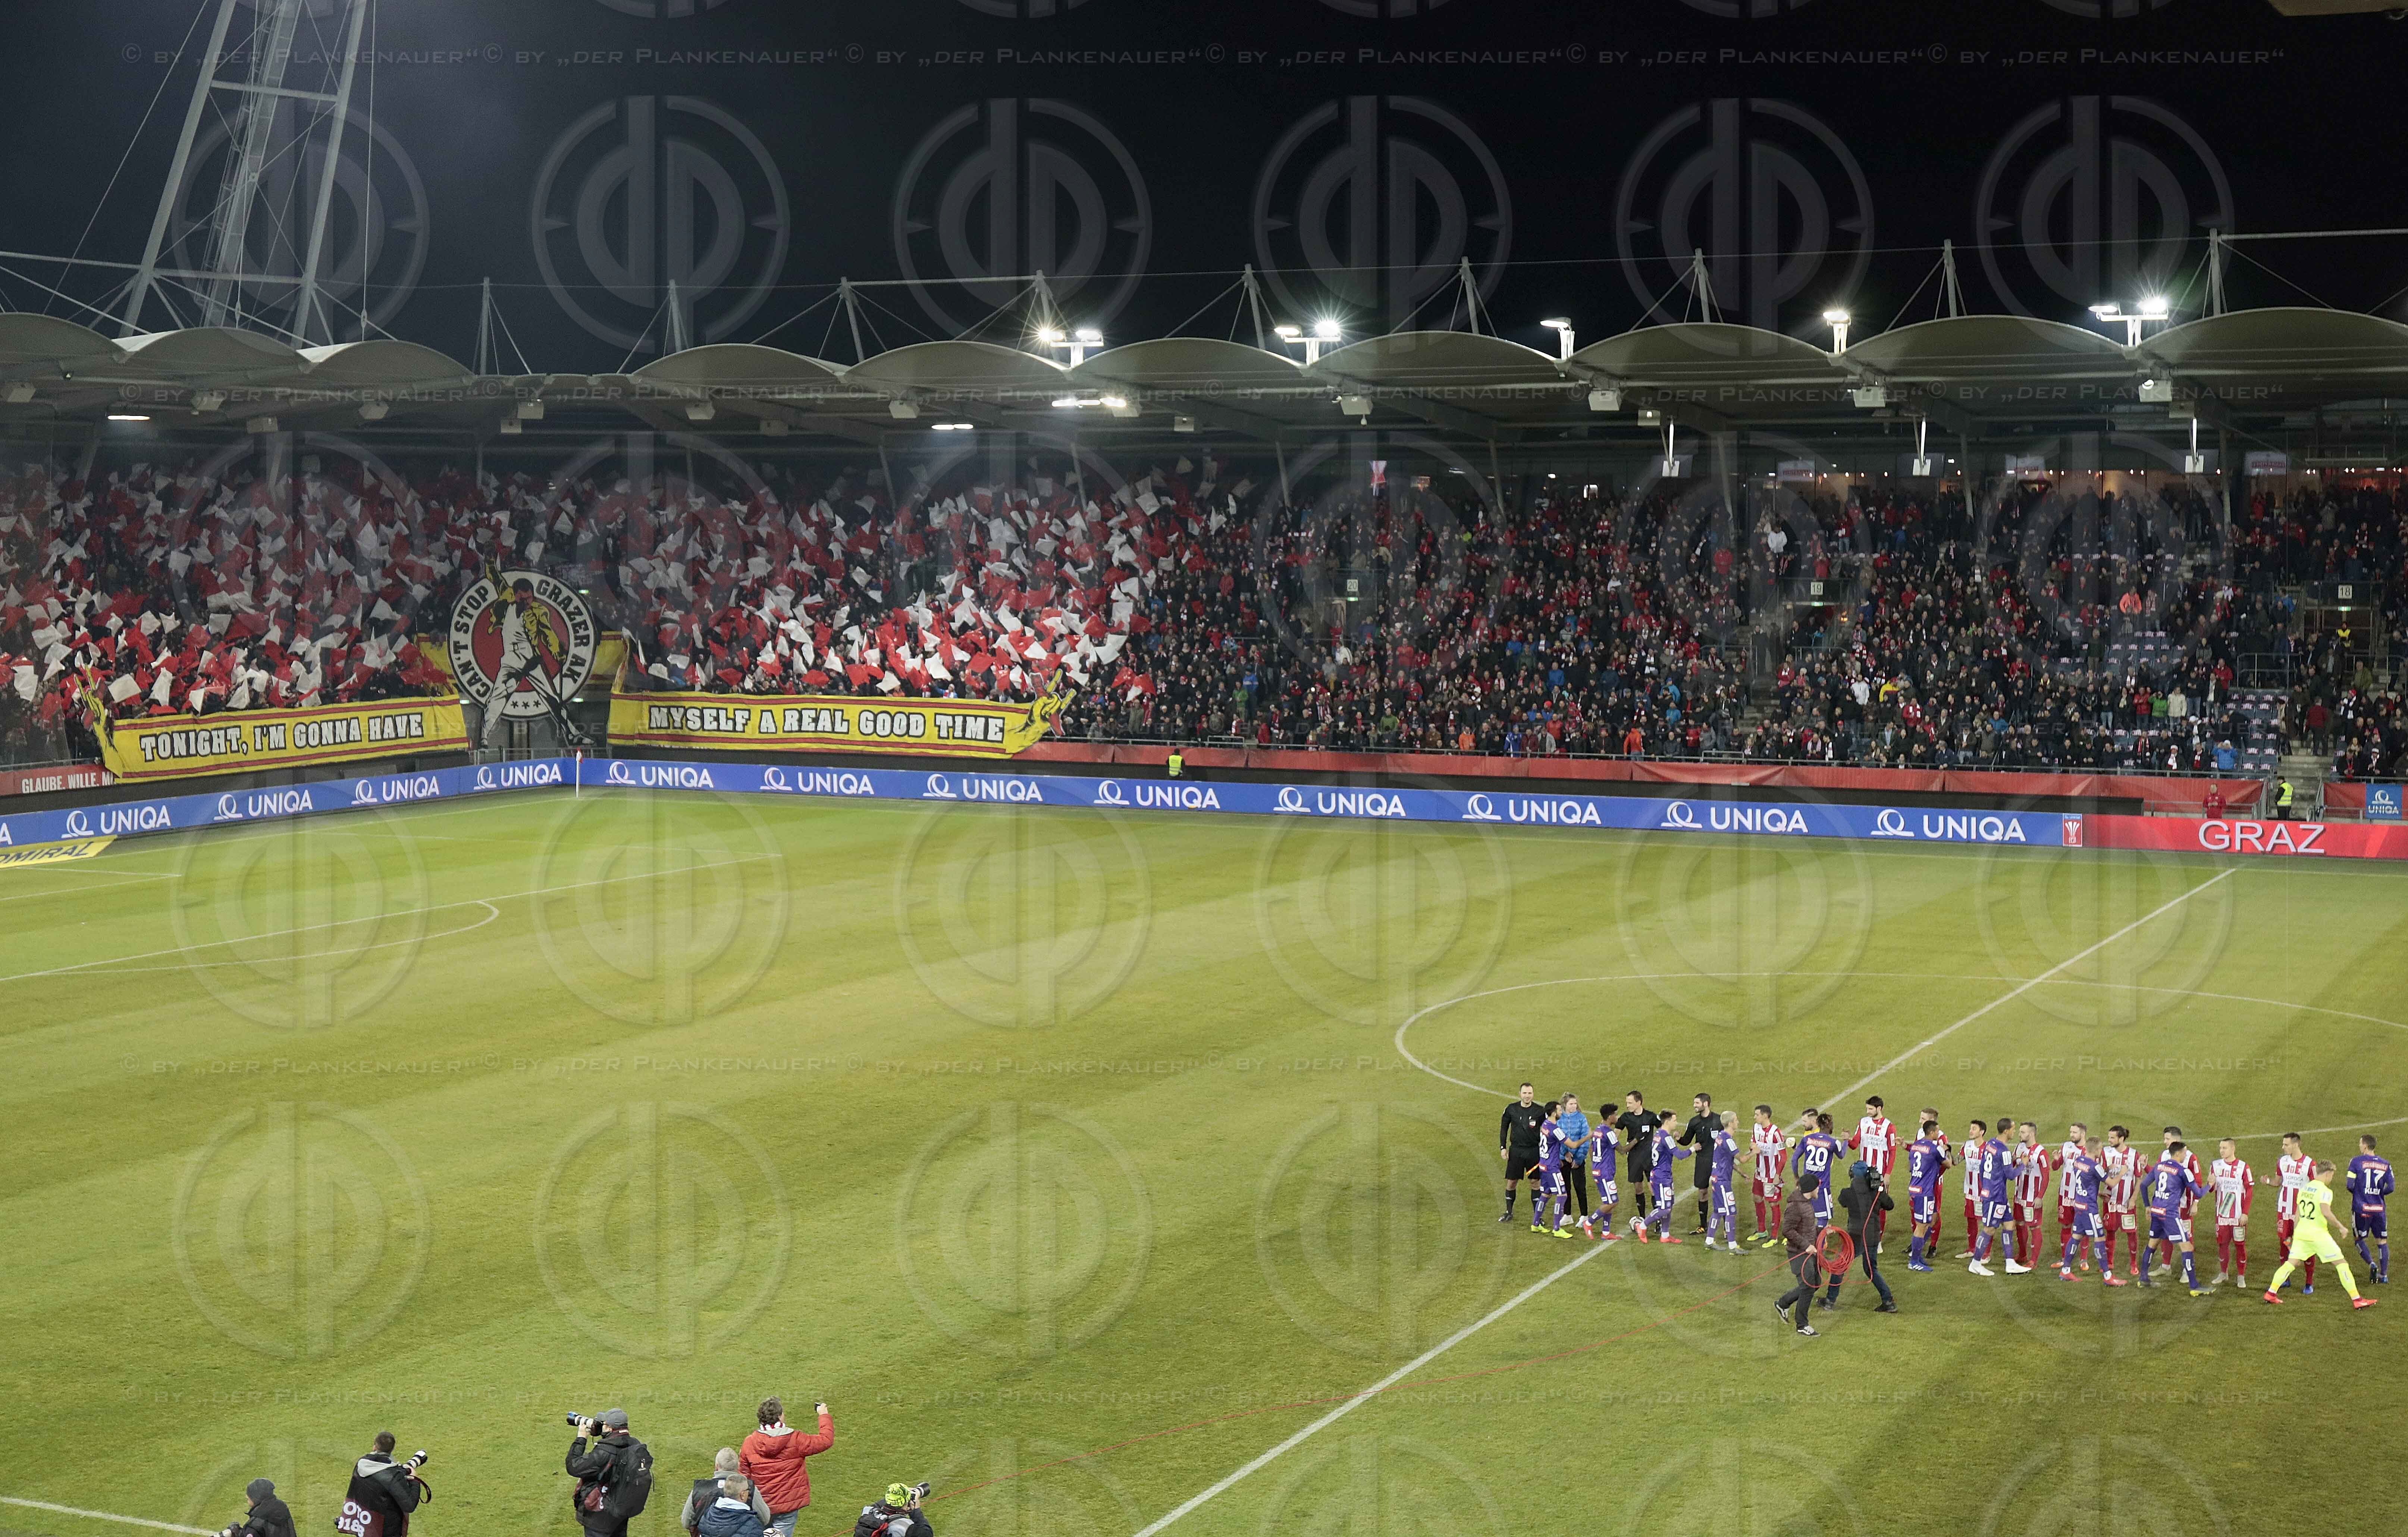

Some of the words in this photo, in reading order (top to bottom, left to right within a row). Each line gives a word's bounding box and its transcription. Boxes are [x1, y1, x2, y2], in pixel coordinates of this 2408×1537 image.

[1348, 581, 1357, 590] 20
[1813, 584, 1822, 593] 19
[2340, 587, 2350, 596] 18
[454, 585, 489, 634] STOP
[536, 579, 590, 647] GRAZER
[453, 640, 490, 698] CAN'T
[562, 653, 586, 684] AK
[648, 705, 750, 732] MYSELF
[759, 709, 777, 734] A
[783, 709, 850, 734] REAL
[858, 710, 926, 737] GOOD
[934, 713, 1006, 743] TIME
[139, 725, 248, 762] TONIGHT,
[254, 723, 286, 751] I'M
[292, 716, 362, 749] GONNA
[367, 712, 424, 742] HAVE
[22, 775, 65, 794] GLAUBE.
[68, 771, 99, 788] WILLE.
[501, 763, 562, 788] UNIQA
[641, 766, 714, 788] UNIQA
[798, 772, 874, 795] UNIQA
[382, 776, 440, 802] UNIQA
[962, 778, 1043, 802] UNIQA
[1135, 785, 1220, 809] UNIQA
[248, 790, 313, 817] UNIQA
[1317, 791, 1406, 818] UNIQA
[1508, 799, 1601, 825] UNIQA
[2368, 804, 2399, 815] UNIQA
[100, 805, 171, 834] UNIQA
[1710, 807, 1809, 834] UNIQA
[1922, 814, 2026, 843] UNIQA
[2198, 820, 2325, 854] GRAZ
[1806, 1145, 1829, 1167] 20
[1913, 1151, 1922, 1171] 3
[2158, 1171, 2168, 1192] 8
[2364, 1168, 2386, 1189] 17
